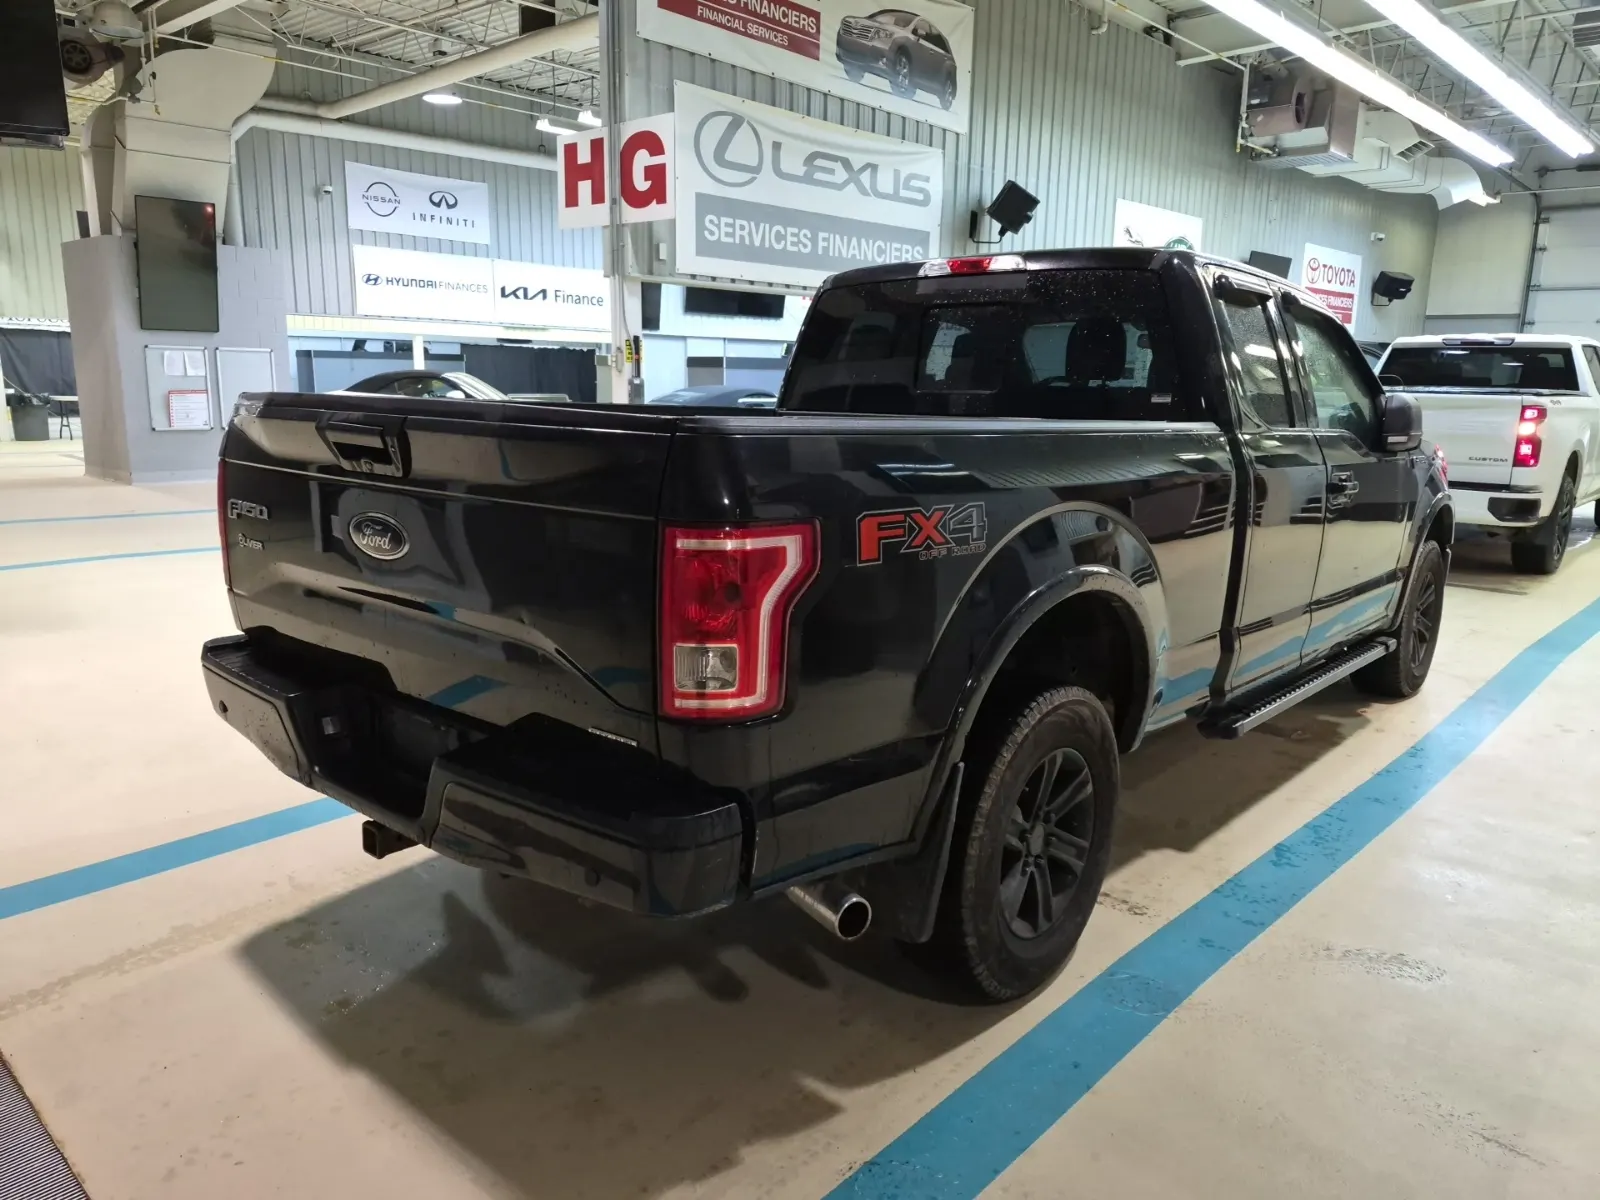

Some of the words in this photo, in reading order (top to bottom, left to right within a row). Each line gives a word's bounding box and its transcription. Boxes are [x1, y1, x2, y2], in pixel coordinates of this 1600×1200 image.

[697, 7, 745, 31] FINANCIAL
[746, 23, 789, 46] SERVICES
[771, 141, 932, 208] LEXUS
[362, 193, 401, 205] NISSAN
[412, 212, 476, 229] INFINITI
[703, 215, 812, 252] SERVICES
[817, 231, 924, 264] FINANCIERS
[385, 276, 437, 290] HYUNDAI
[438, 280, 488, 294] FINANCES
[1321, 264, 1356, 287] TOYOTA
[500, 286, 547, 301] KIA
[554, 289, 604, 306] Finance
[359, 521, 392, 551] Ford
[856, 501, 987, 566] FX4
[918, 548, 948, 560] OFF
